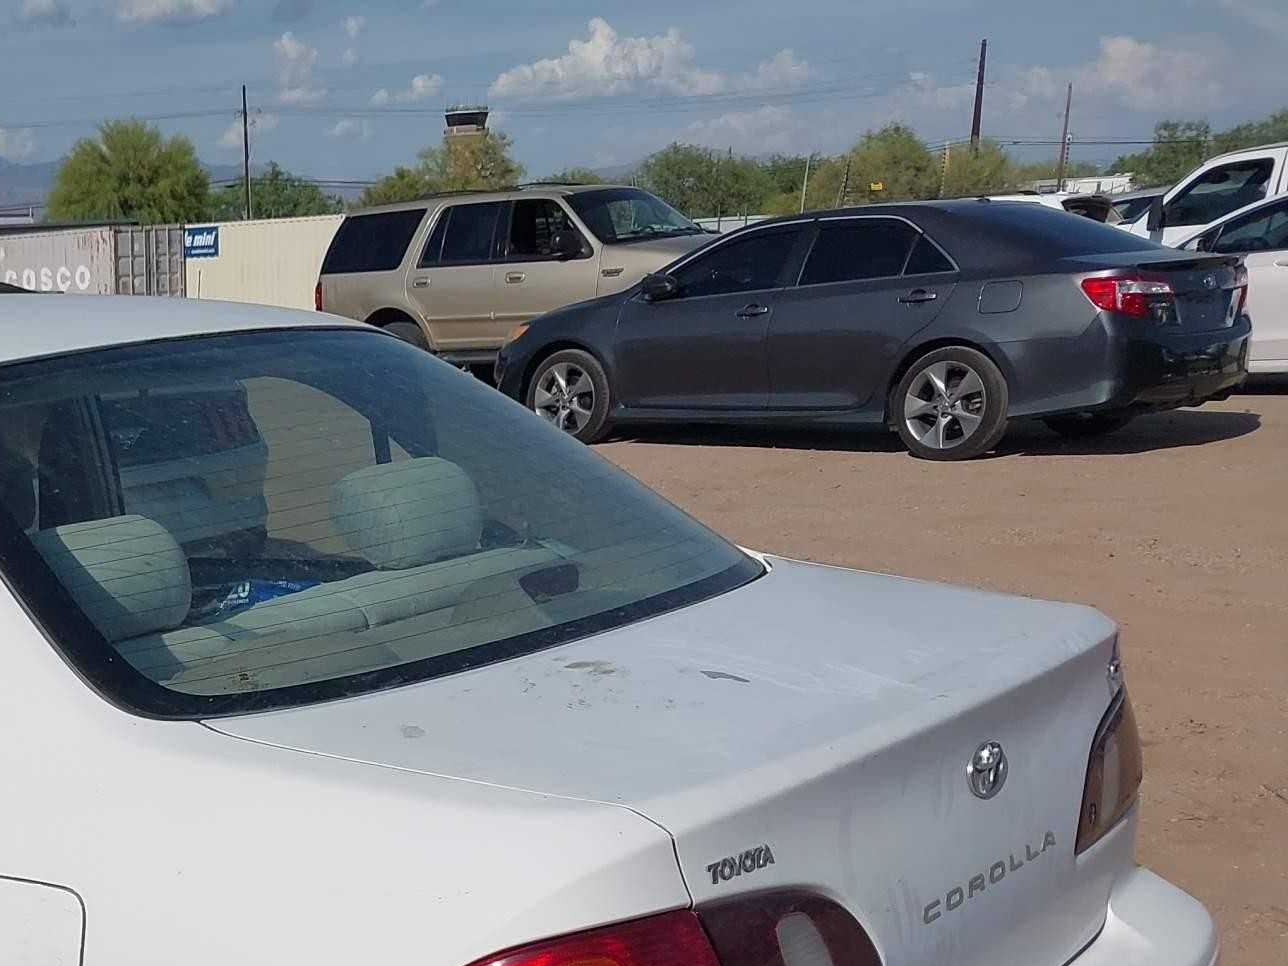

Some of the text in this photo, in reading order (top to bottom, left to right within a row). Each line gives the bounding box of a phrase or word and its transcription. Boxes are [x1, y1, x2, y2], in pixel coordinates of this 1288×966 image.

[192, 230, 216, 247] mini
[5, 264, 91, 292] COSCO
[707, 844, 775, 885] TOYOTA
[923, 830, 1057, 925] COROLLA
